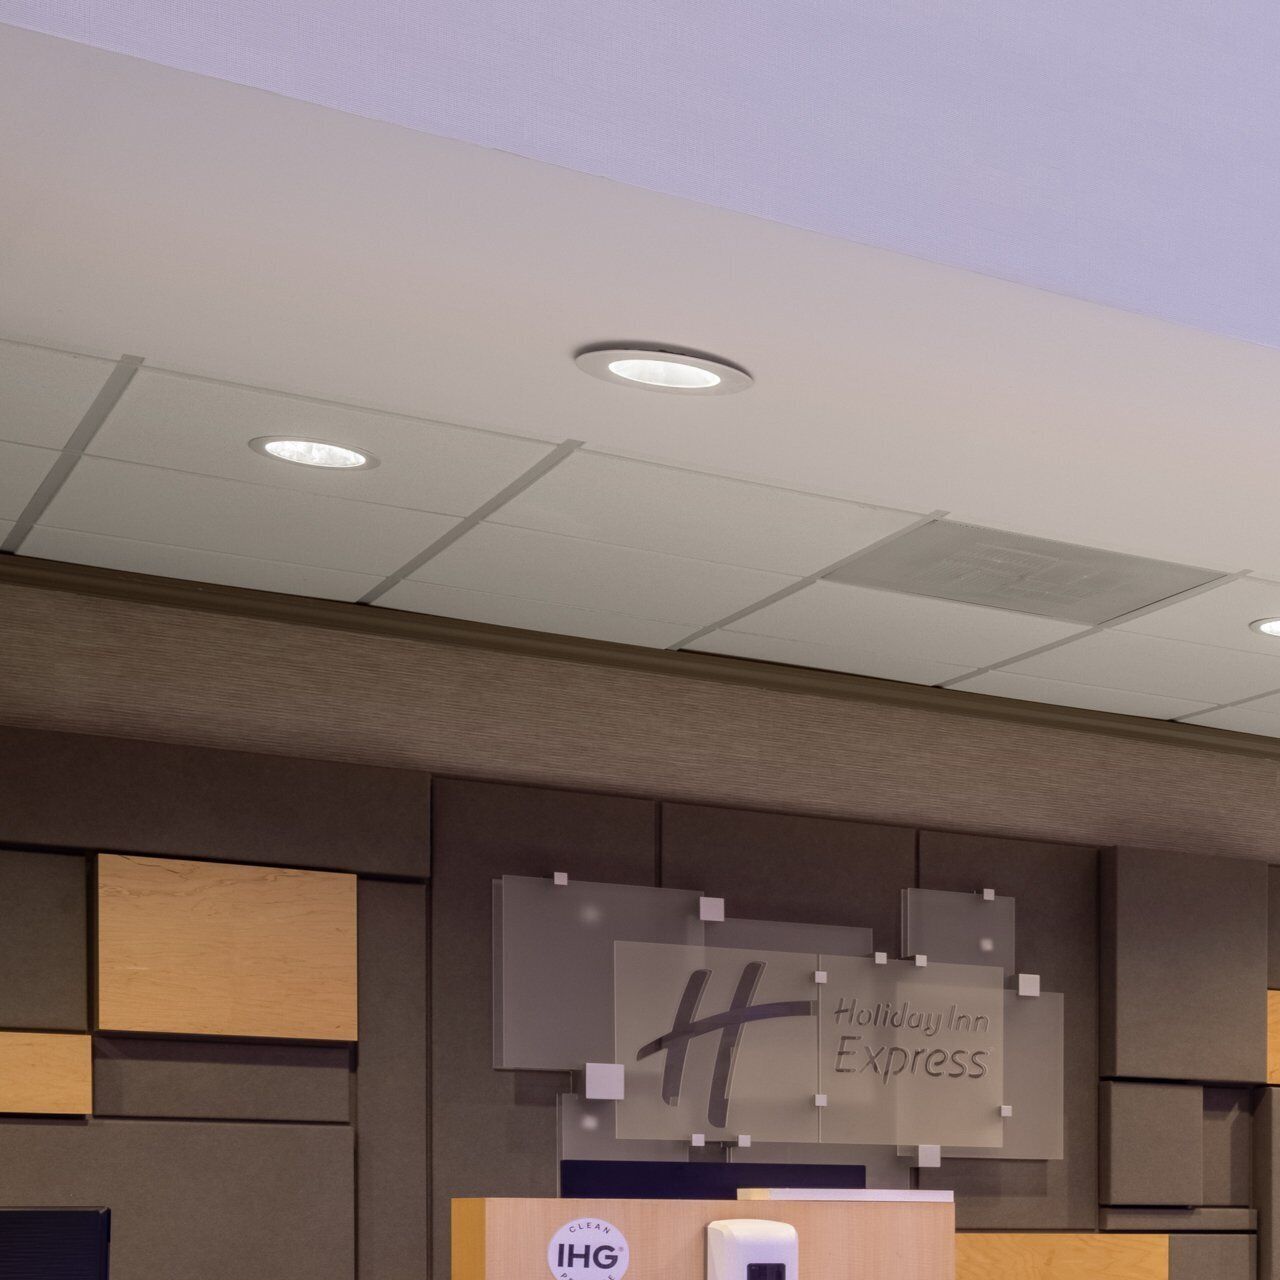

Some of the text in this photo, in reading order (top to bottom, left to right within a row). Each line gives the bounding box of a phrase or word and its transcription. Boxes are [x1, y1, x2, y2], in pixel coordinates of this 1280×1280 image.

[834, 997, 991, 1036] Holiday Inn
[834, 1035, 990, 1085] Express
[568, 1221, 611, 1235] CLEAN
